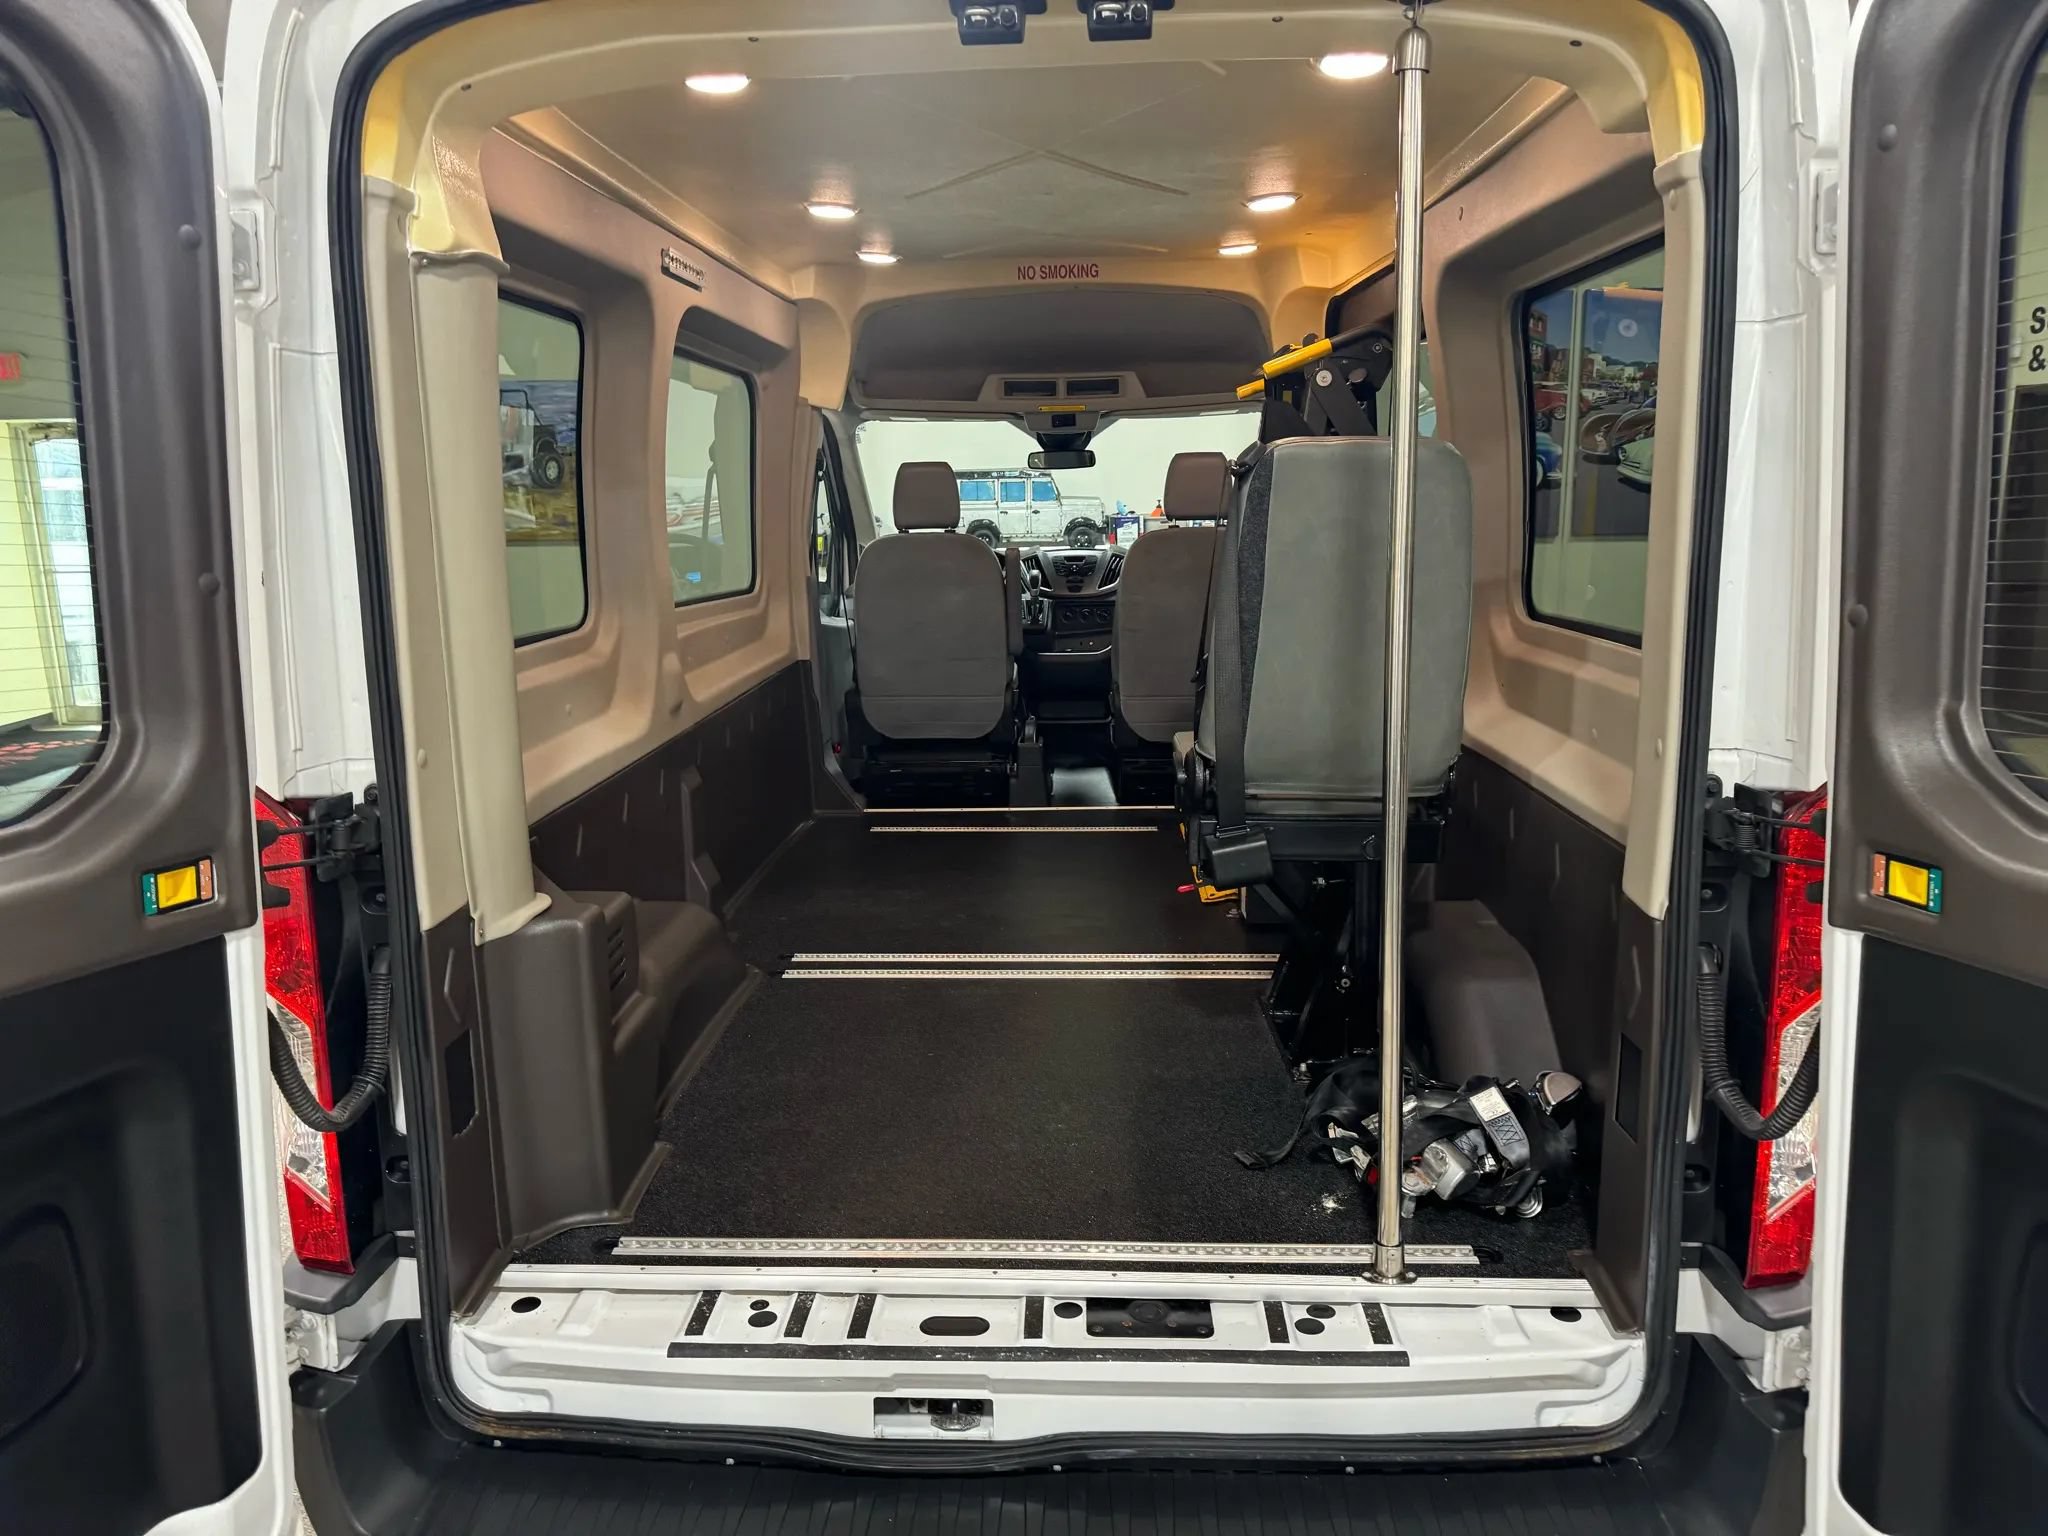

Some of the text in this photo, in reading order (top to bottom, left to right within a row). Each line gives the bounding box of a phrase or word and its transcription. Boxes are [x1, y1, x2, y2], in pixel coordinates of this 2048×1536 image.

[1017, 263, 1099, 281] NO SMOKING
[2030, 306, 2048, 334] S
[2028, 344, 2046, 372] &
